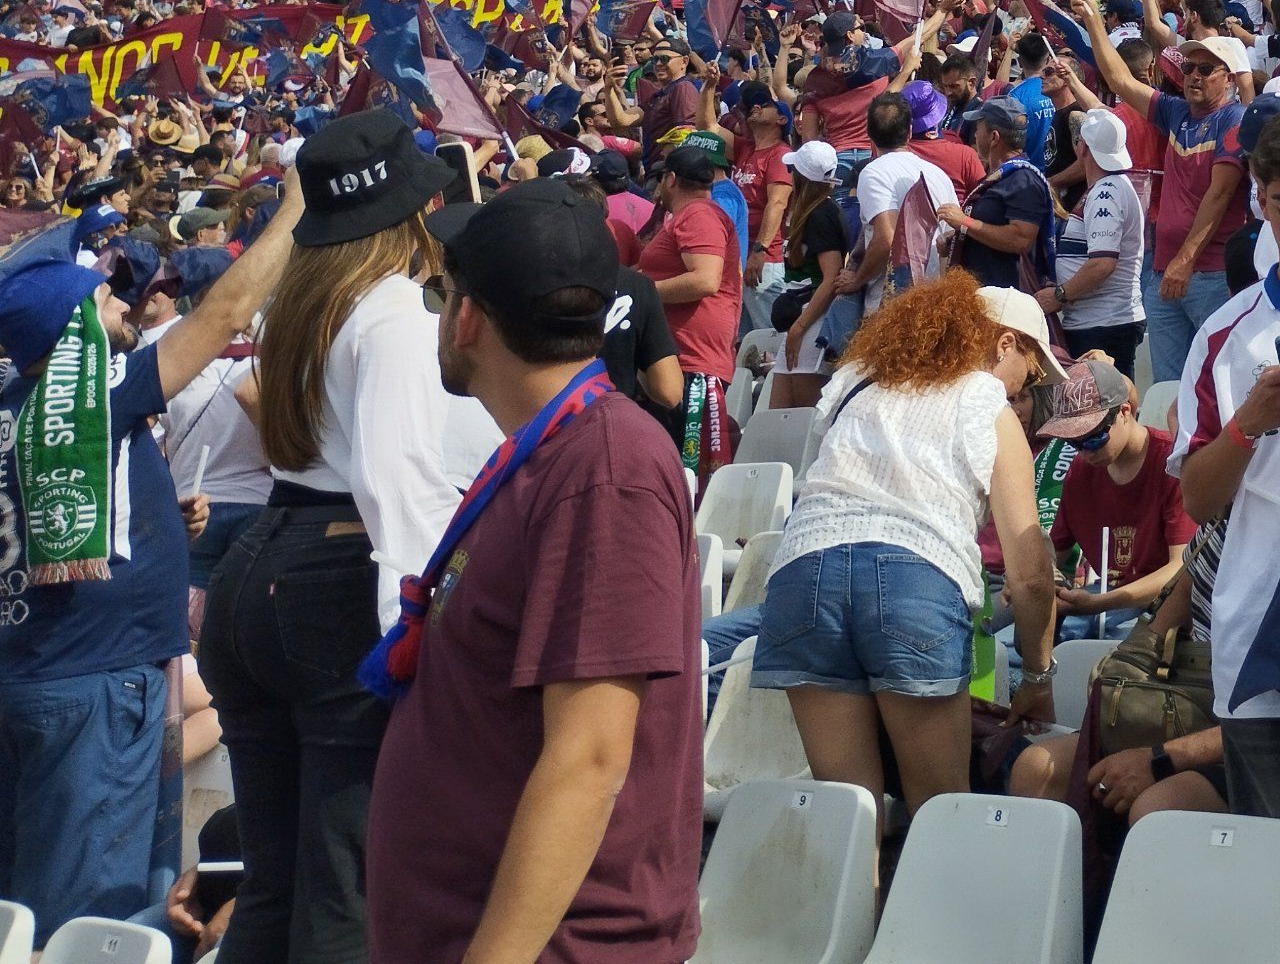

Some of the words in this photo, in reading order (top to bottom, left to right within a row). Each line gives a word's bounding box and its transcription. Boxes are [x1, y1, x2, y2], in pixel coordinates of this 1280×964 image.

[329, 160, 387, 196] 1917
[87, 343, 97, 377] 2025/26
[44, 335, 83, 446] SPORTING
[85, 379, 96, 408] ÉPOCA
[25, 423, 34, 435] DE
[24, 436, 33, 461] TAÇA
[25, 462, 33, 486] FINAL
[36, 468, 86, 487] SCP
[34, 487, 89, 508] SPORTING
[1039, 497, 1061, 509] SC
[37, 531, 87, 551] PORTUGAL
[799, 796, 806, 806] 9
[994, 810, 1002, 822] 8
[1221, 832, 1228, 844] 7
